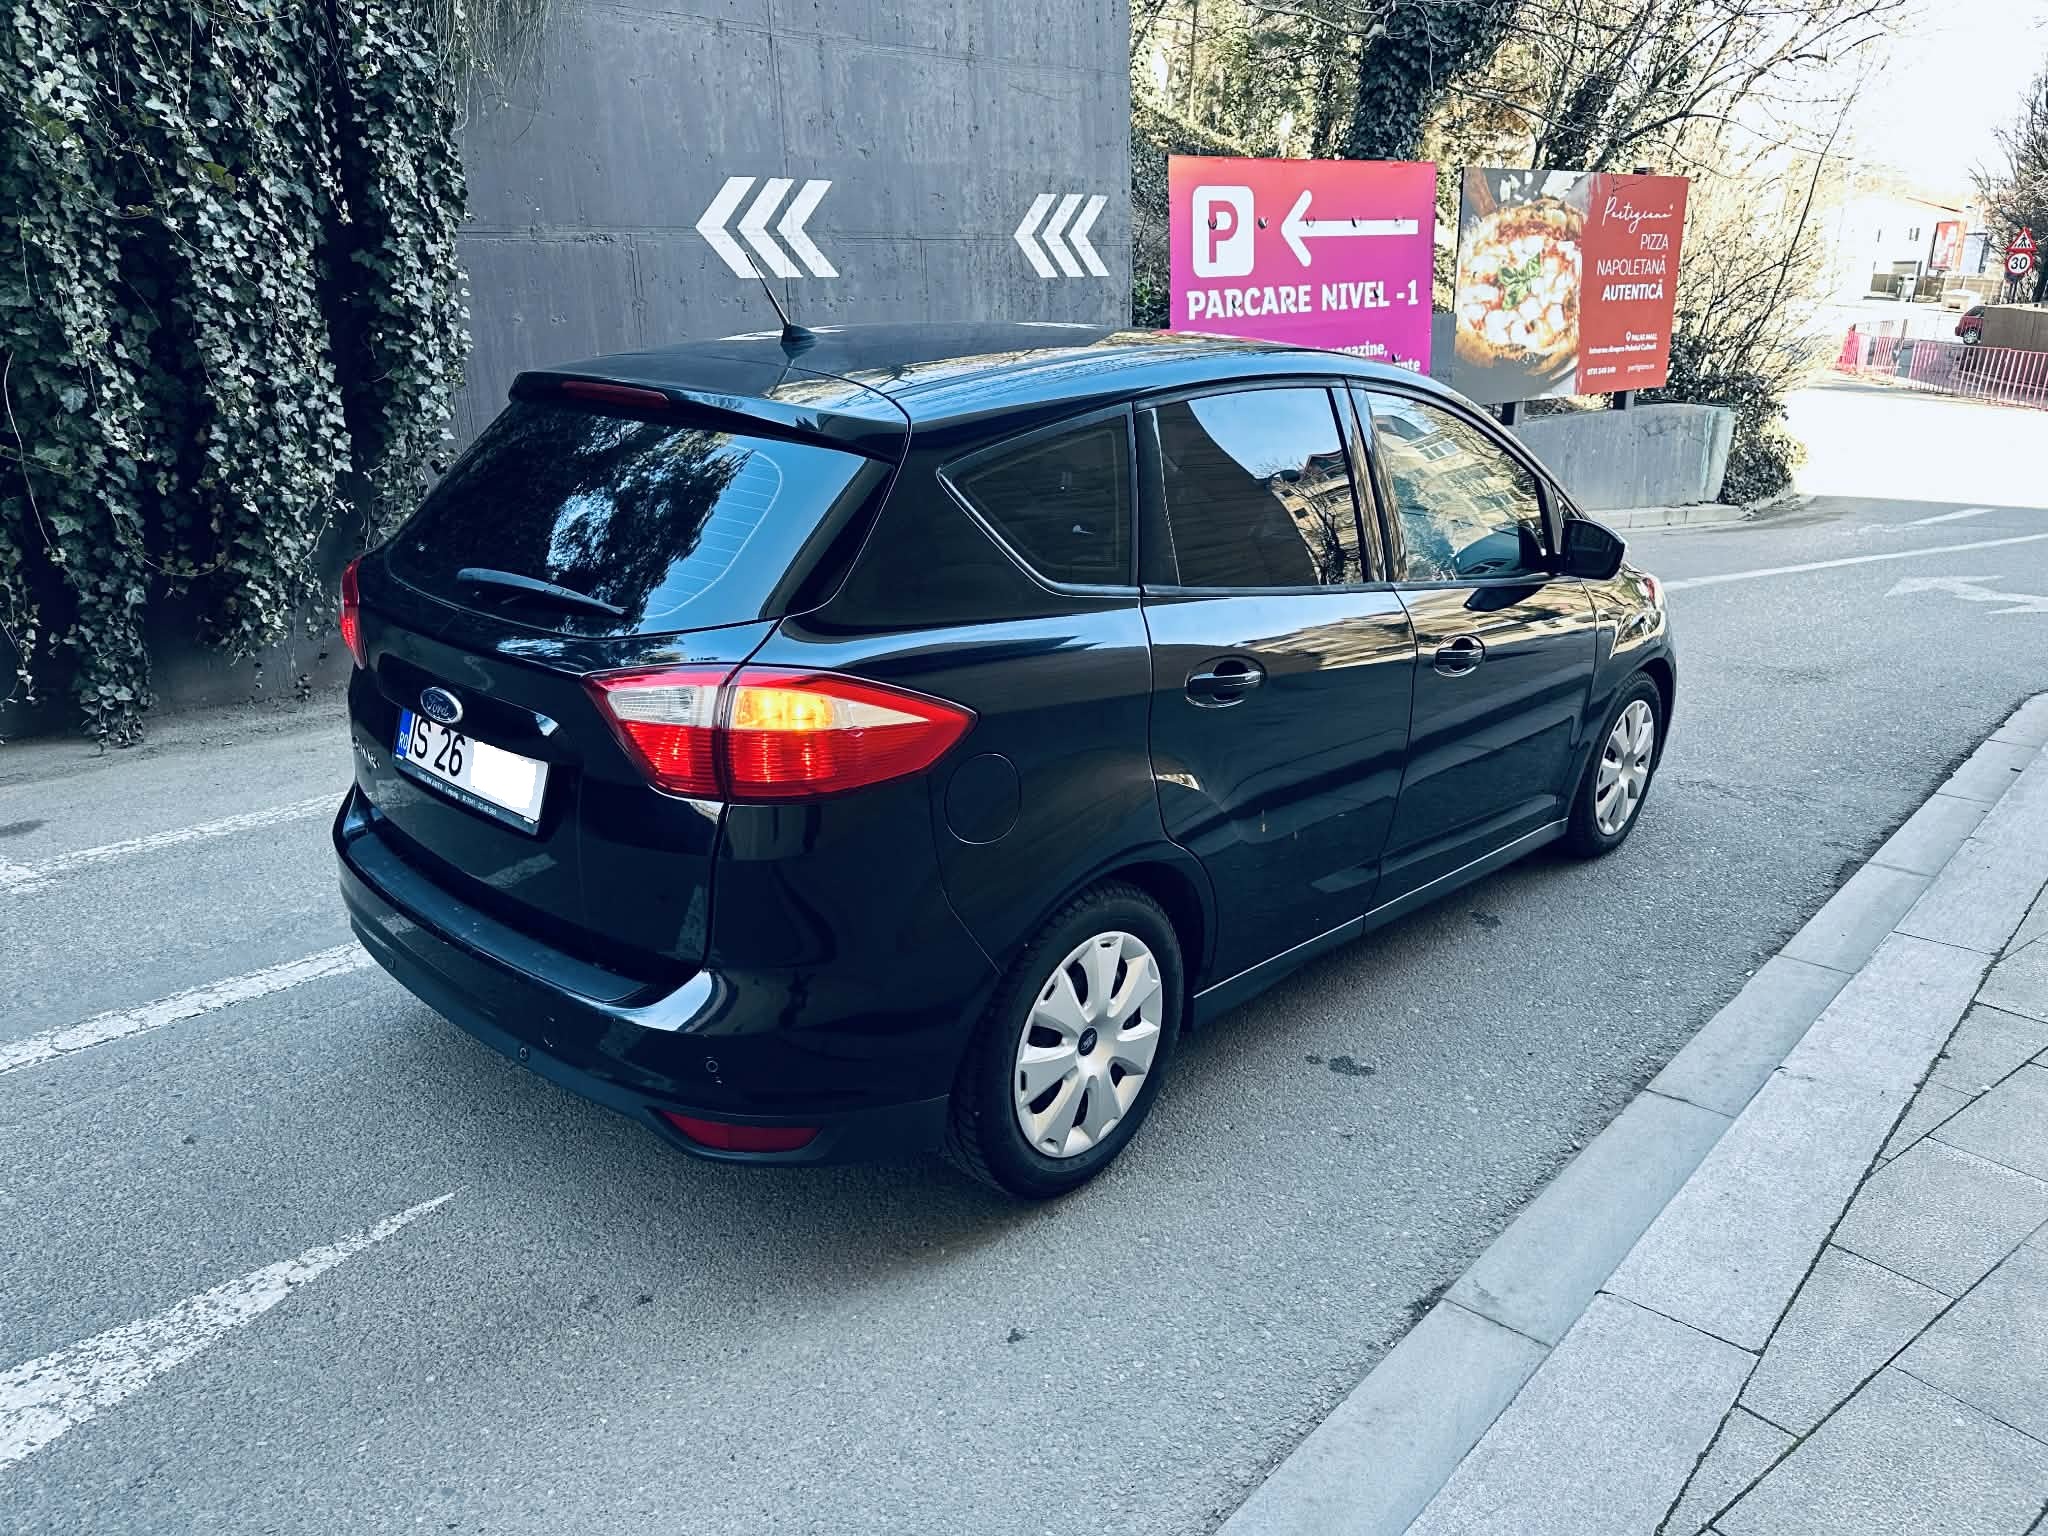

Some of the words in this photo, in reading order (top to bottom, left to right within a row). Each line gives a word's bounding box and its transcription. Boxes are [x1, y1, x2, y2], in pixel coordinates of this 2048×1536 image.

[1208, 200, 1239, 264] P
[1640, 233, 1669, 250] PIZZA
[1596, 254, 1667, 276] NAPOLETANĂ
[2010, 257, 2028, 270] 30
[1186, 284, 1312, 320] PARCARE
[1321, 281, 1391, 311] NIVEL
[1396, 279, 1419, 305] -1
[1601, 279, 1664, 301] AUTENTICĂ
[426, 693, 450, 717] Ford
[398, 731, 409, 751] RO
[408, 713, 432, 759] IS
[434, 728, 466, 777] 26
